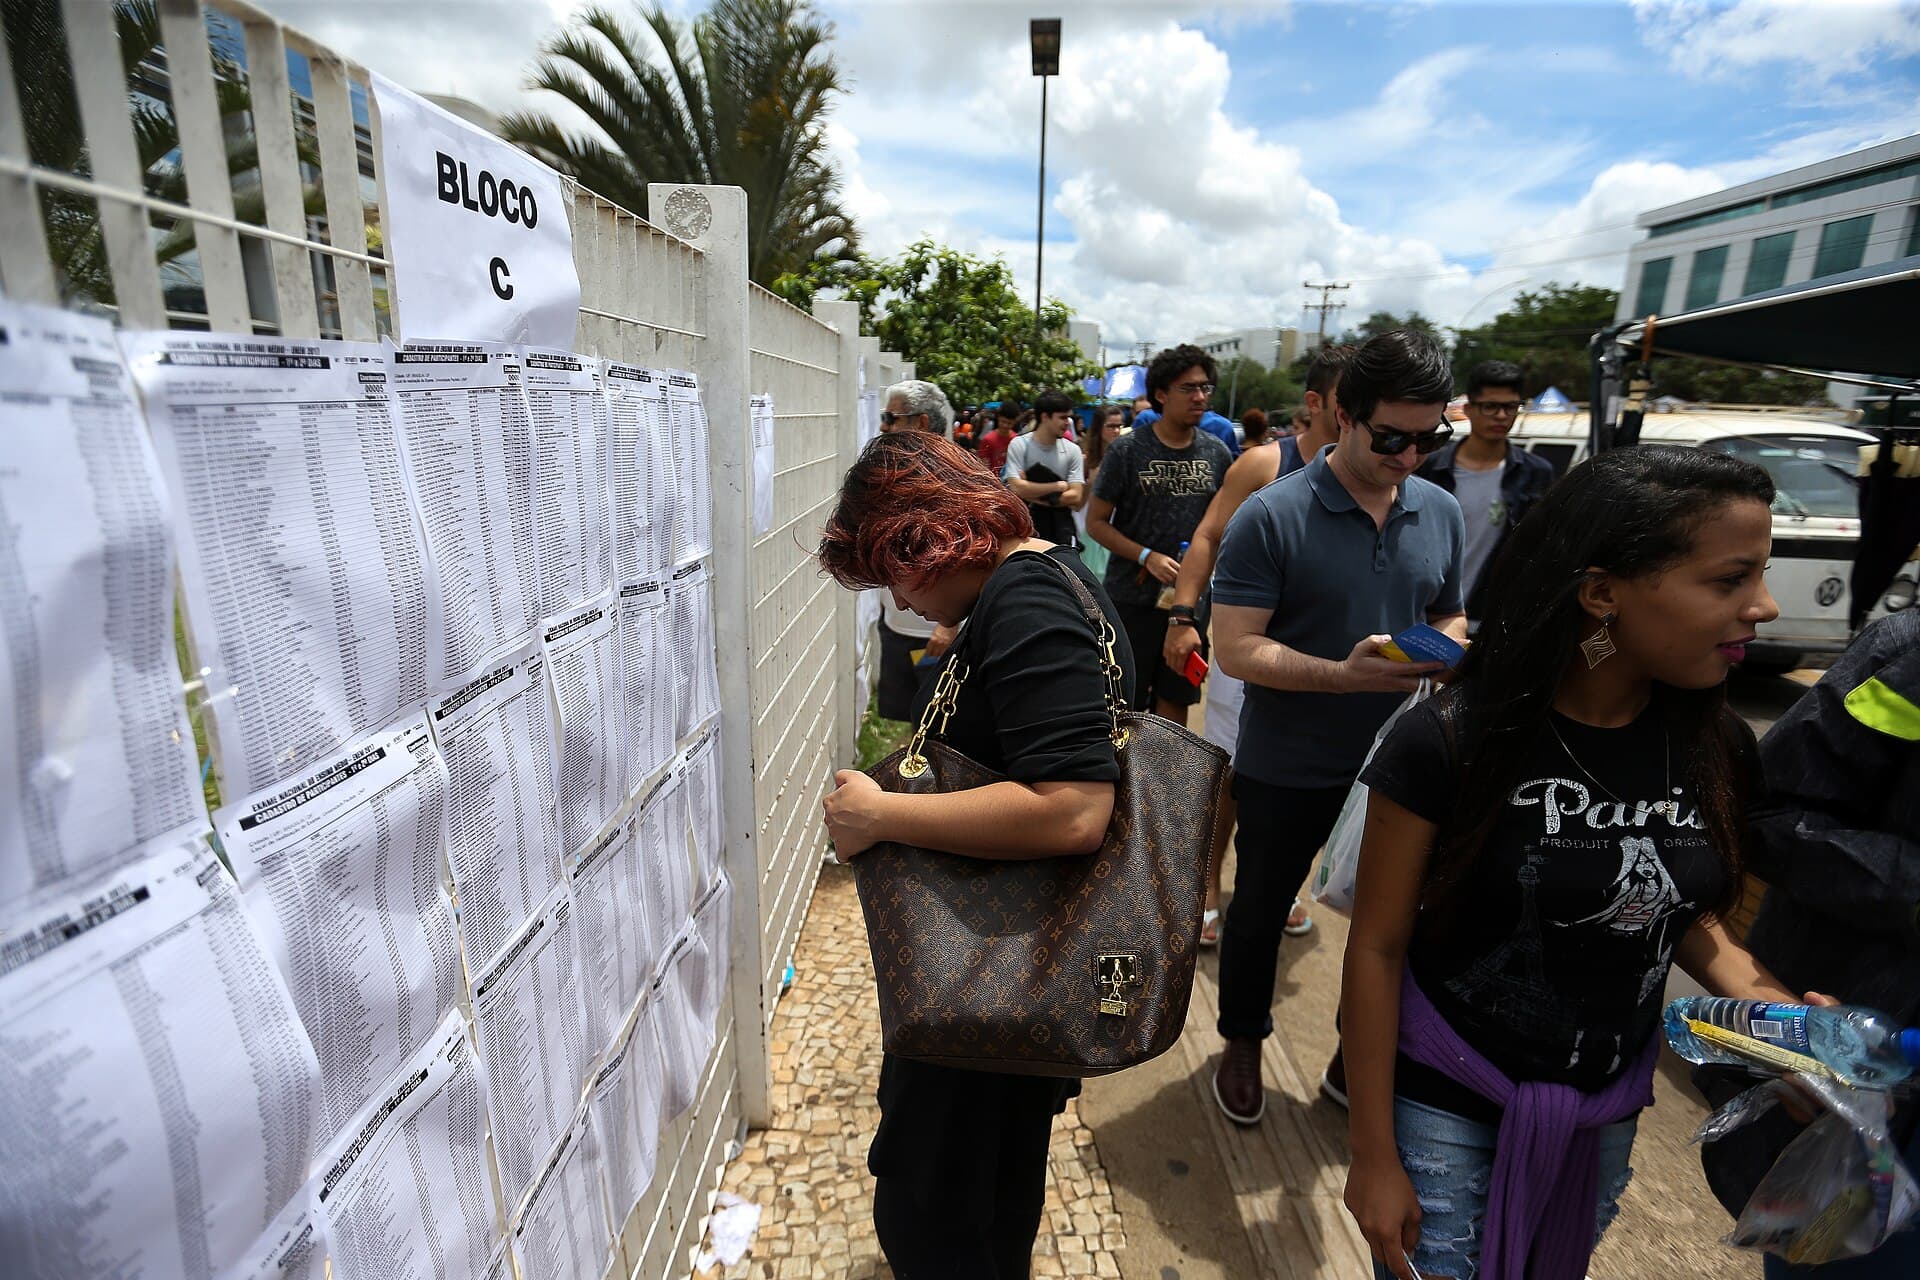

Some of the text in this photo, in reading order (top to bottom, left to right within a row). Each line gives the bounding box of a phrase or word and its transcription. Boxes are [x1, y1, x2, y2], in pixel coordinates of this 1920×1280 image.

[435, 150, 538, 230] BLOCO
[489, 257, 514, 301] C
[1139, 460, 1214, 477] STAR
[1140, 477, 1216, 496] WARS
[255, 798, 297, 824] CADASTRO
[1540, 837, 1610, 849] PRODUIT
[326, 1158, 353, 1192] CADASTRO
